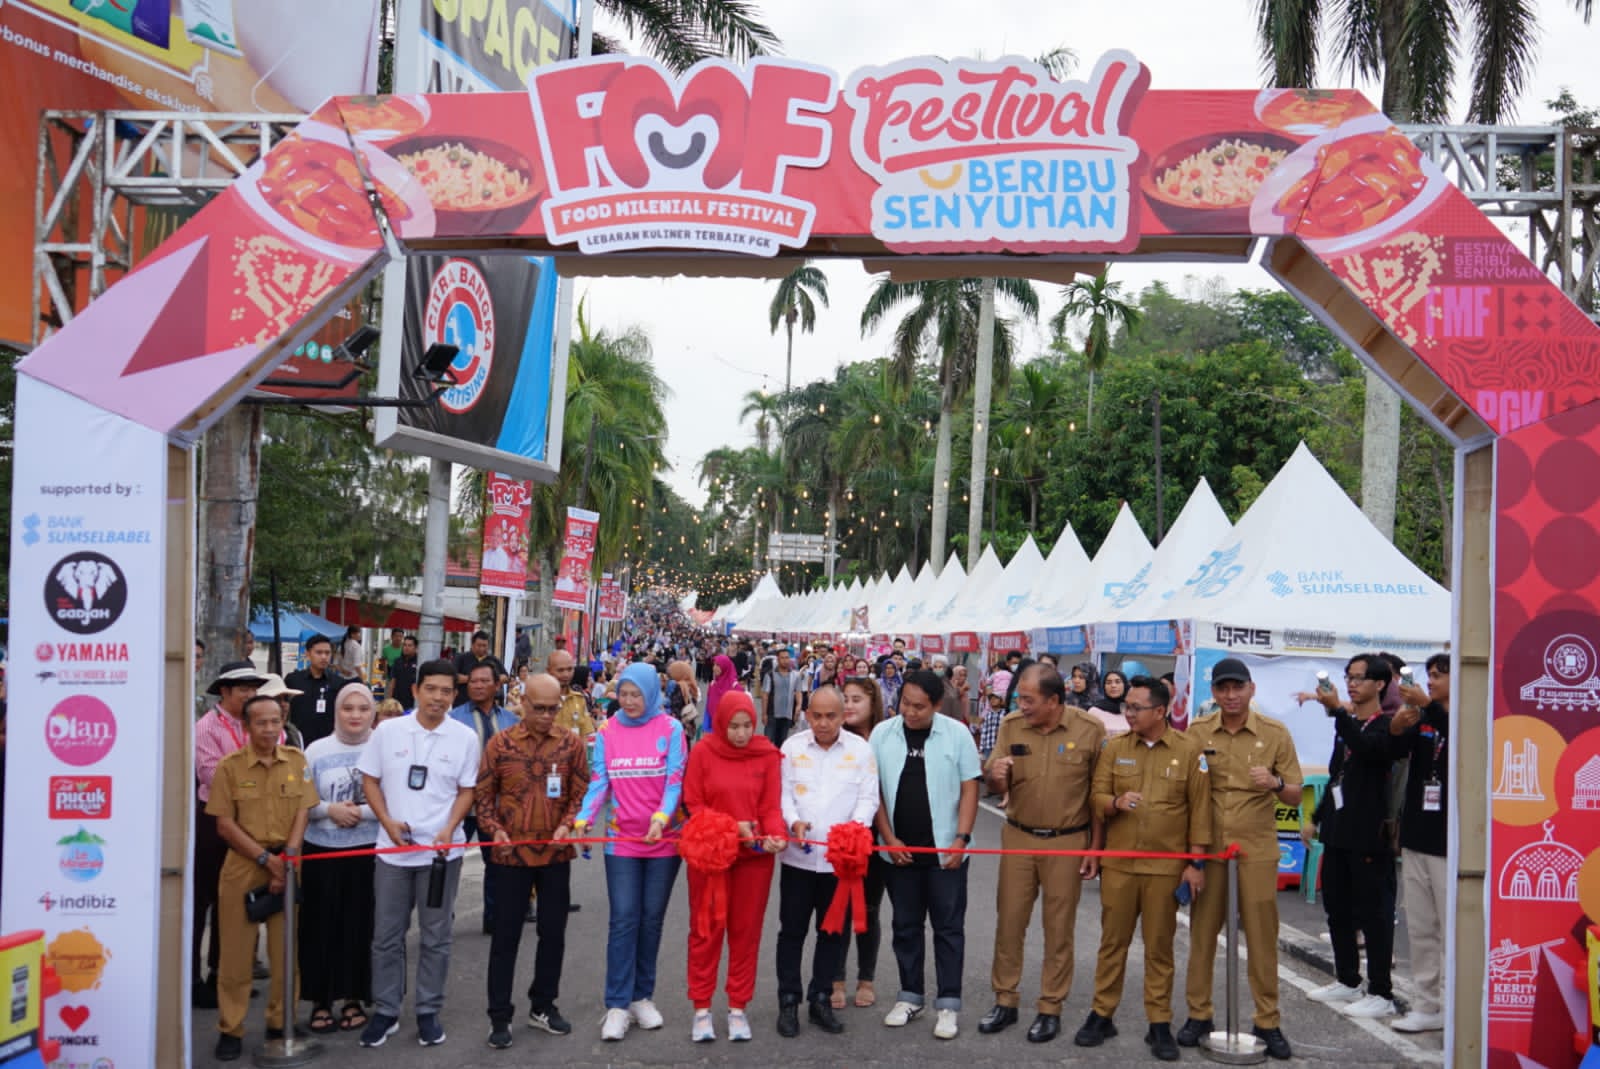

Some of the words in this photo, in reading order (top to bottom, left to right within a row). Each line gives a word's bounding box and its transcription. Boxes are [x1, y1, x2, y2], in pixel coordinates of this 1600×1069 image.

[53, 49, 144, 95] merchandise
[856, 61, 1127, 164] Festival
[968, 158, 1116, 192] BERIBU
[561, 204, 610, 226] FOOD
[615, 200, 703, 217] MILENIAL
[707, 200, 795, 228] FESTIVAL
[883, 195, 1116, 229] SENYUMAN
[586, 230, 640, 247] LEBARAN
[642, 229, 691, 241] KULINER
[694, 229, 743, 244] TERBAIK
[745, 234, 771, 249] PGK
[1454, 255, 1510, 266] BERIBU
[1454, 267, 1540, 279] SENYUMAN
[428, 268, 456, 331] CITRA
[459, 266, 493, 351] BANGKA
[40, 484, 112, 497] supported
[116, 484, 132, 497] by
[47, 516, 84, 528] BANK
[47, 531, 152, 544] SUMSELBABEL
[1297, 570, 1344, 583] BANK
[1302, 583, 1429, 595] SUMSELBABEL
[1216, 623, 1272, 647] QRIS
[57, 643, 129, 661] YAMAHA
[60, 894, 116, 908] indibiz
